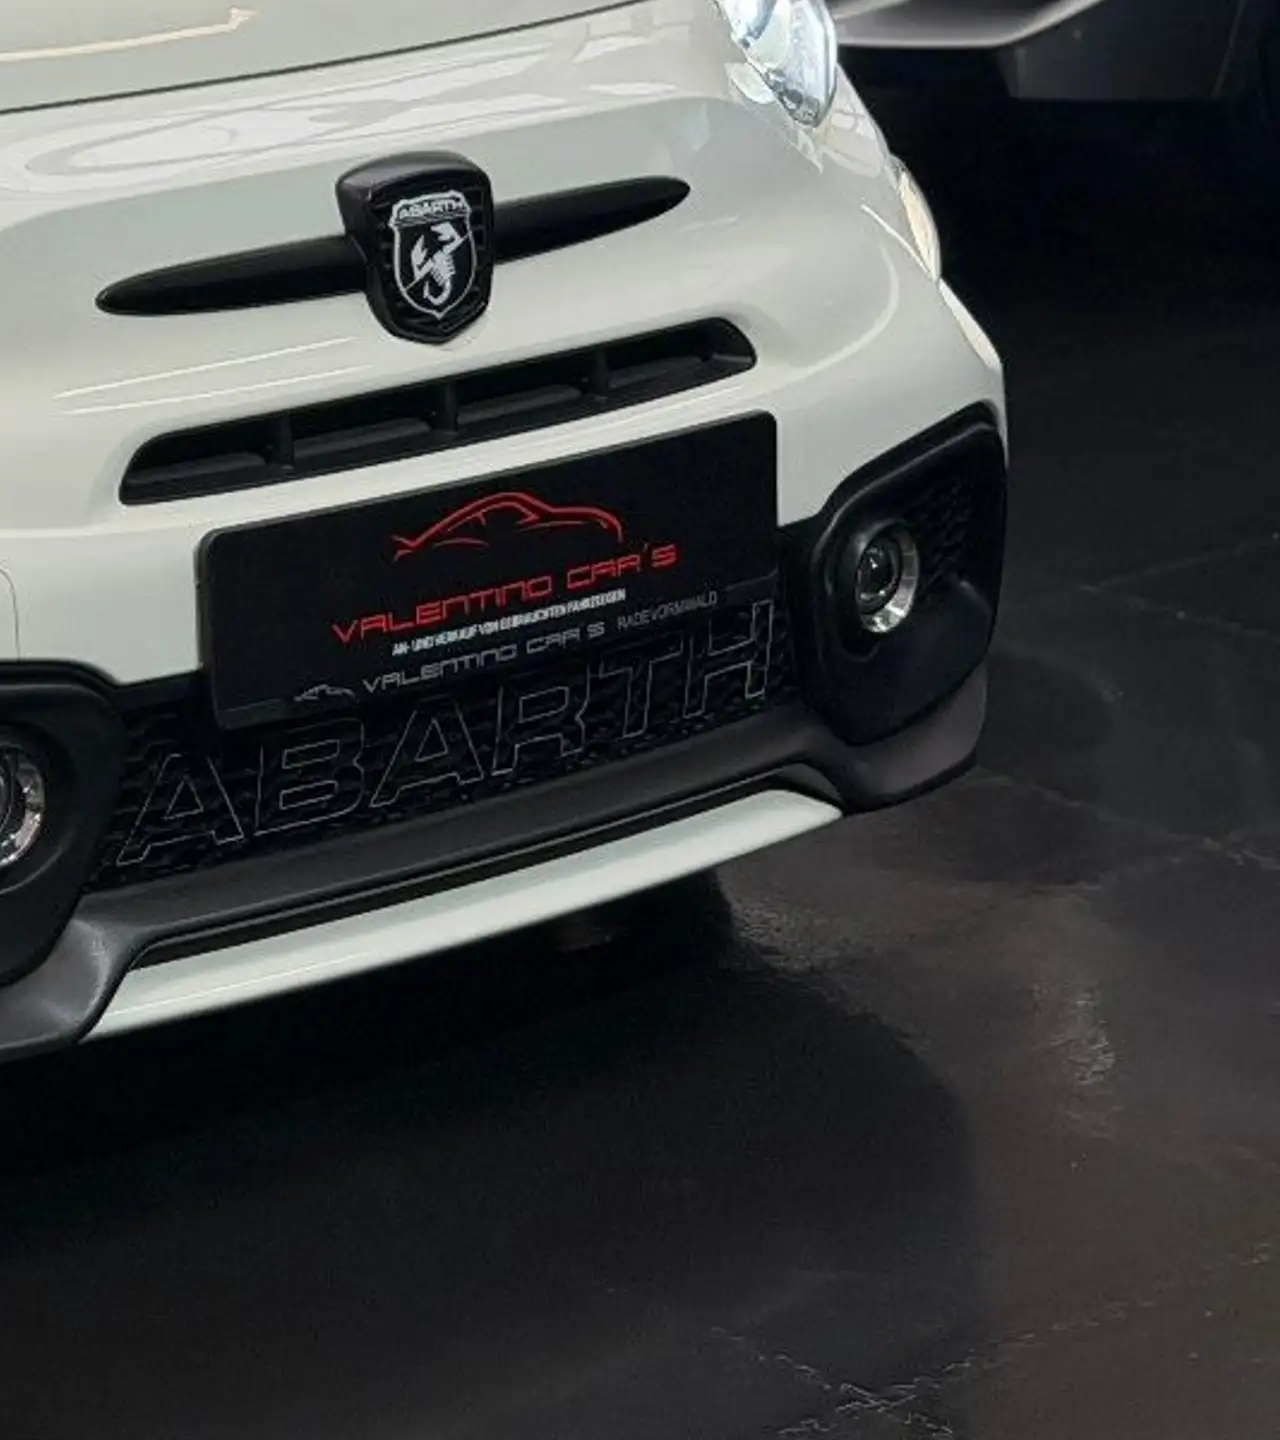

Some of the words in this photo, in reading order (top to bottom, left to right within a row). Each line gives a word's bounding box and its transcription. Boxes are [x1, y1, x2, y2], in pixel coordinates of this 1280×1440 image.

[399, 199, 467, 217] ABARTH
[332, 574, 552, 643] VALENTINO
[362, 643, 518, 693] VALENTINO
[116, 599, 775, 867] ABARTH
